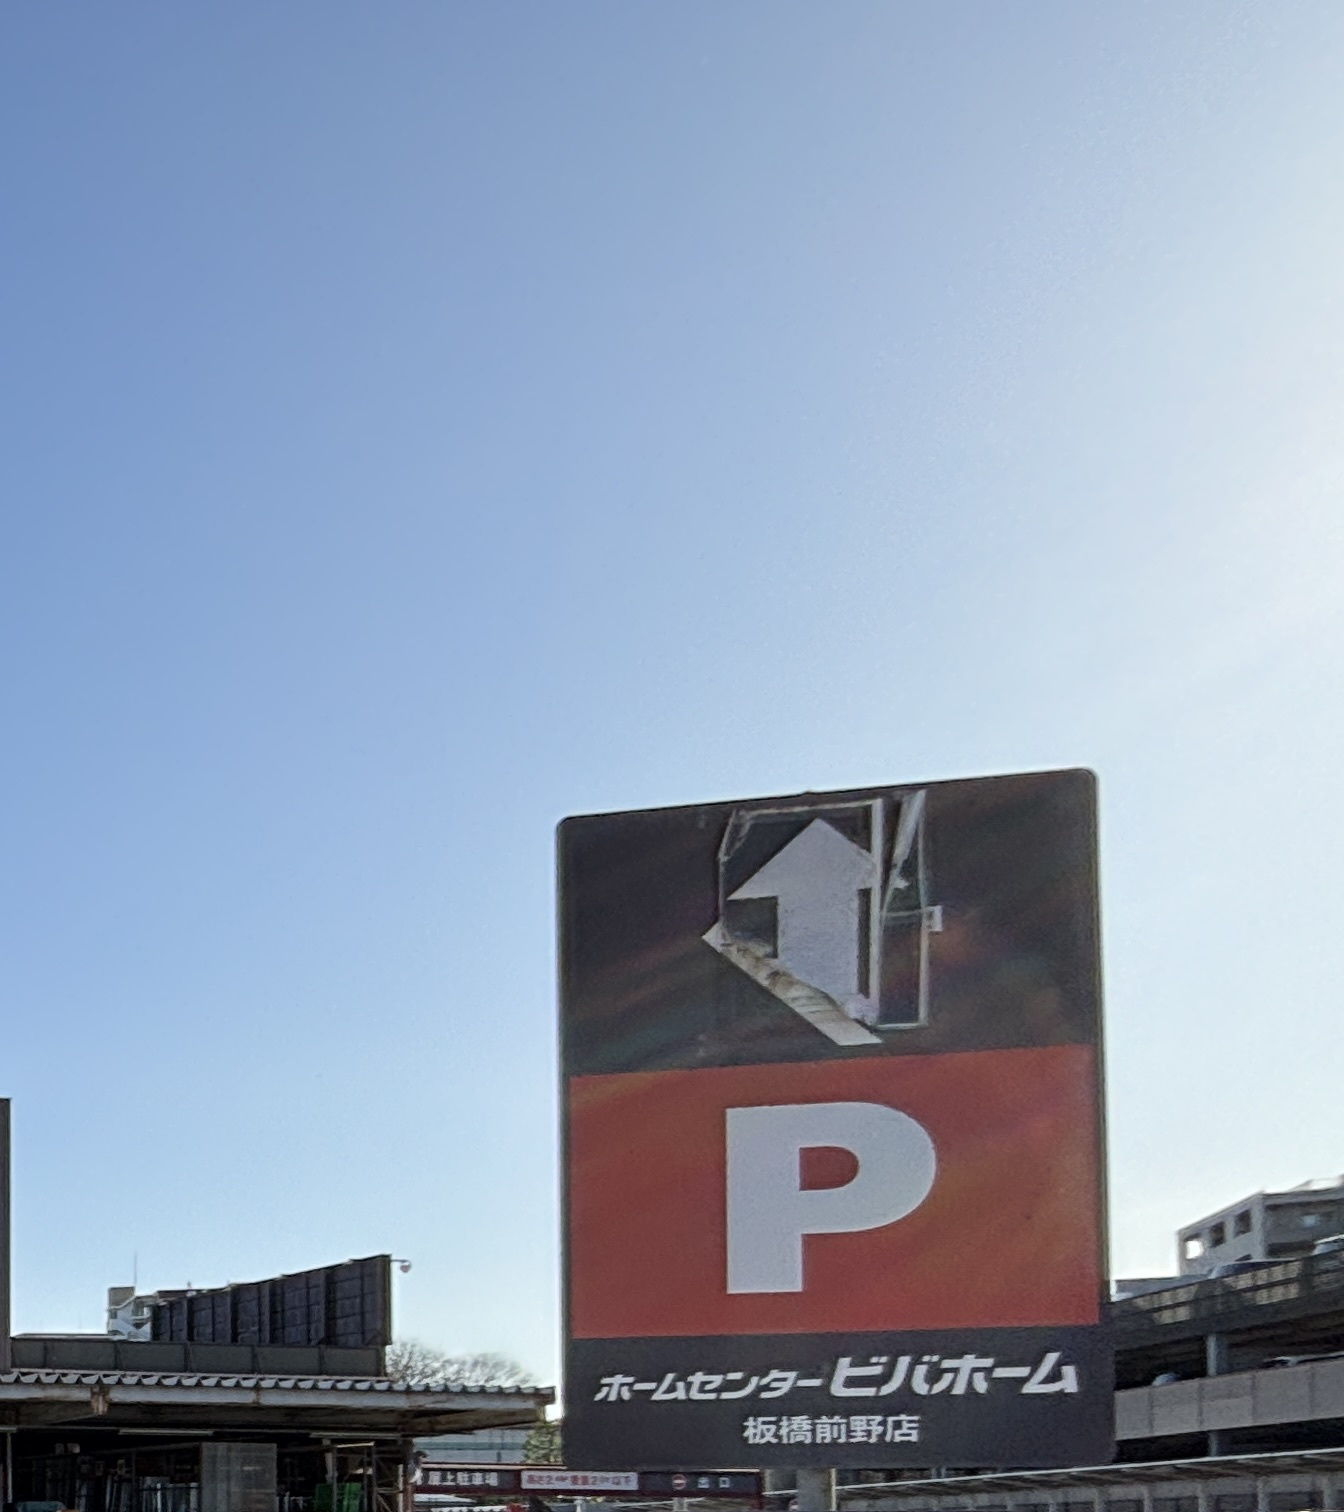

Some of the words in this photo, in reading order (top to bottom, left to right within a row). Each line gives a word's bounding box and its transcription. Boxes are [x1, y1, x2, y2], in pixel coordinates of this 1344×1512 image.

[725, 1101, 937, 1295] P
[593, 1352, 1080, 1402] ホームセンタービバホーム
[742, 1414, 920, 1446] 板橋前野店
